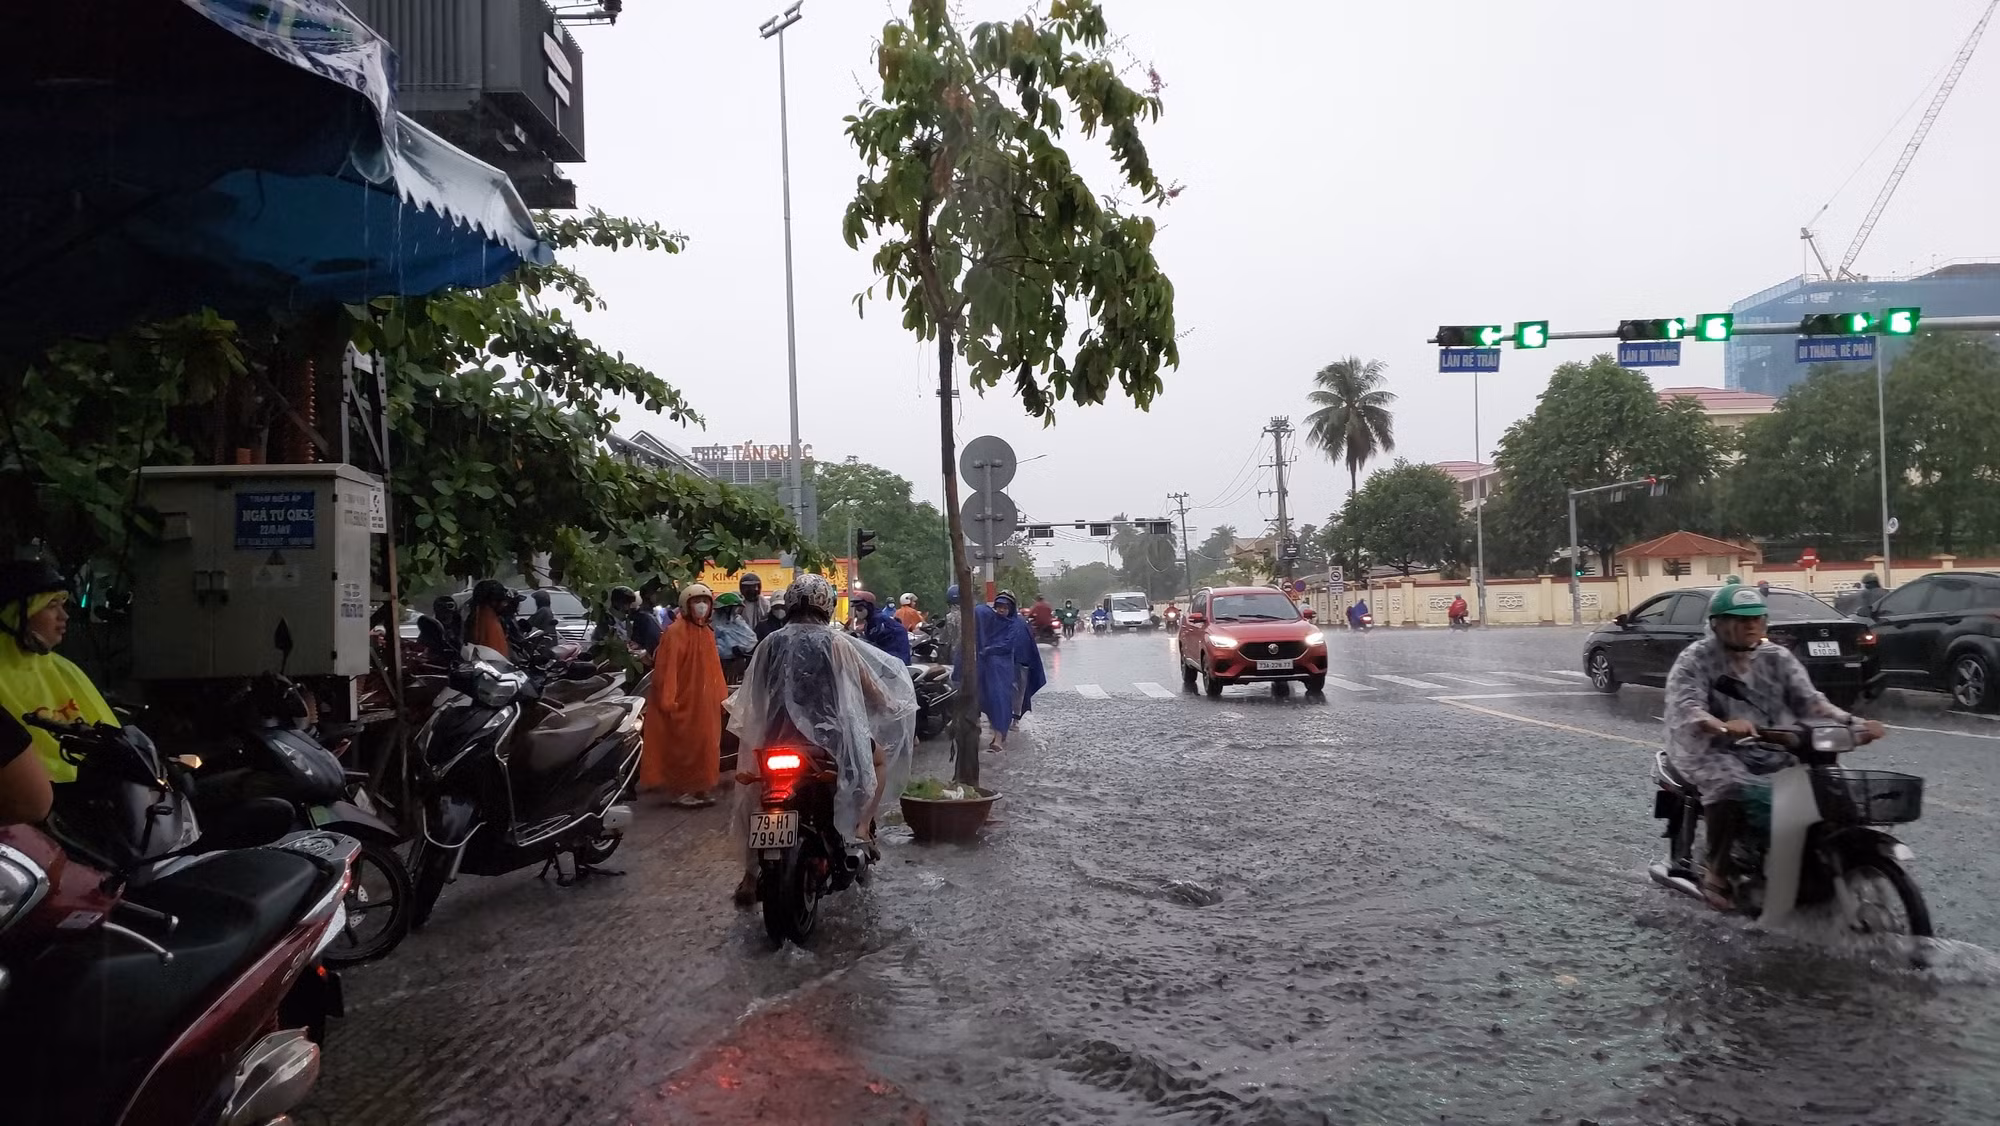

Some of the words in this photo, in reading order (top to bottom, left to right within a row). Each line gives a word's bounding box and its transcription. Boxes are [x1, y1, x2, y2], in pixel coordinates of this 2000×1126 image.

[768, 438, 813, 461] QUC
[757, 814, 789, 830] 79-H1
[751, 830, 794, 847] 799.40
